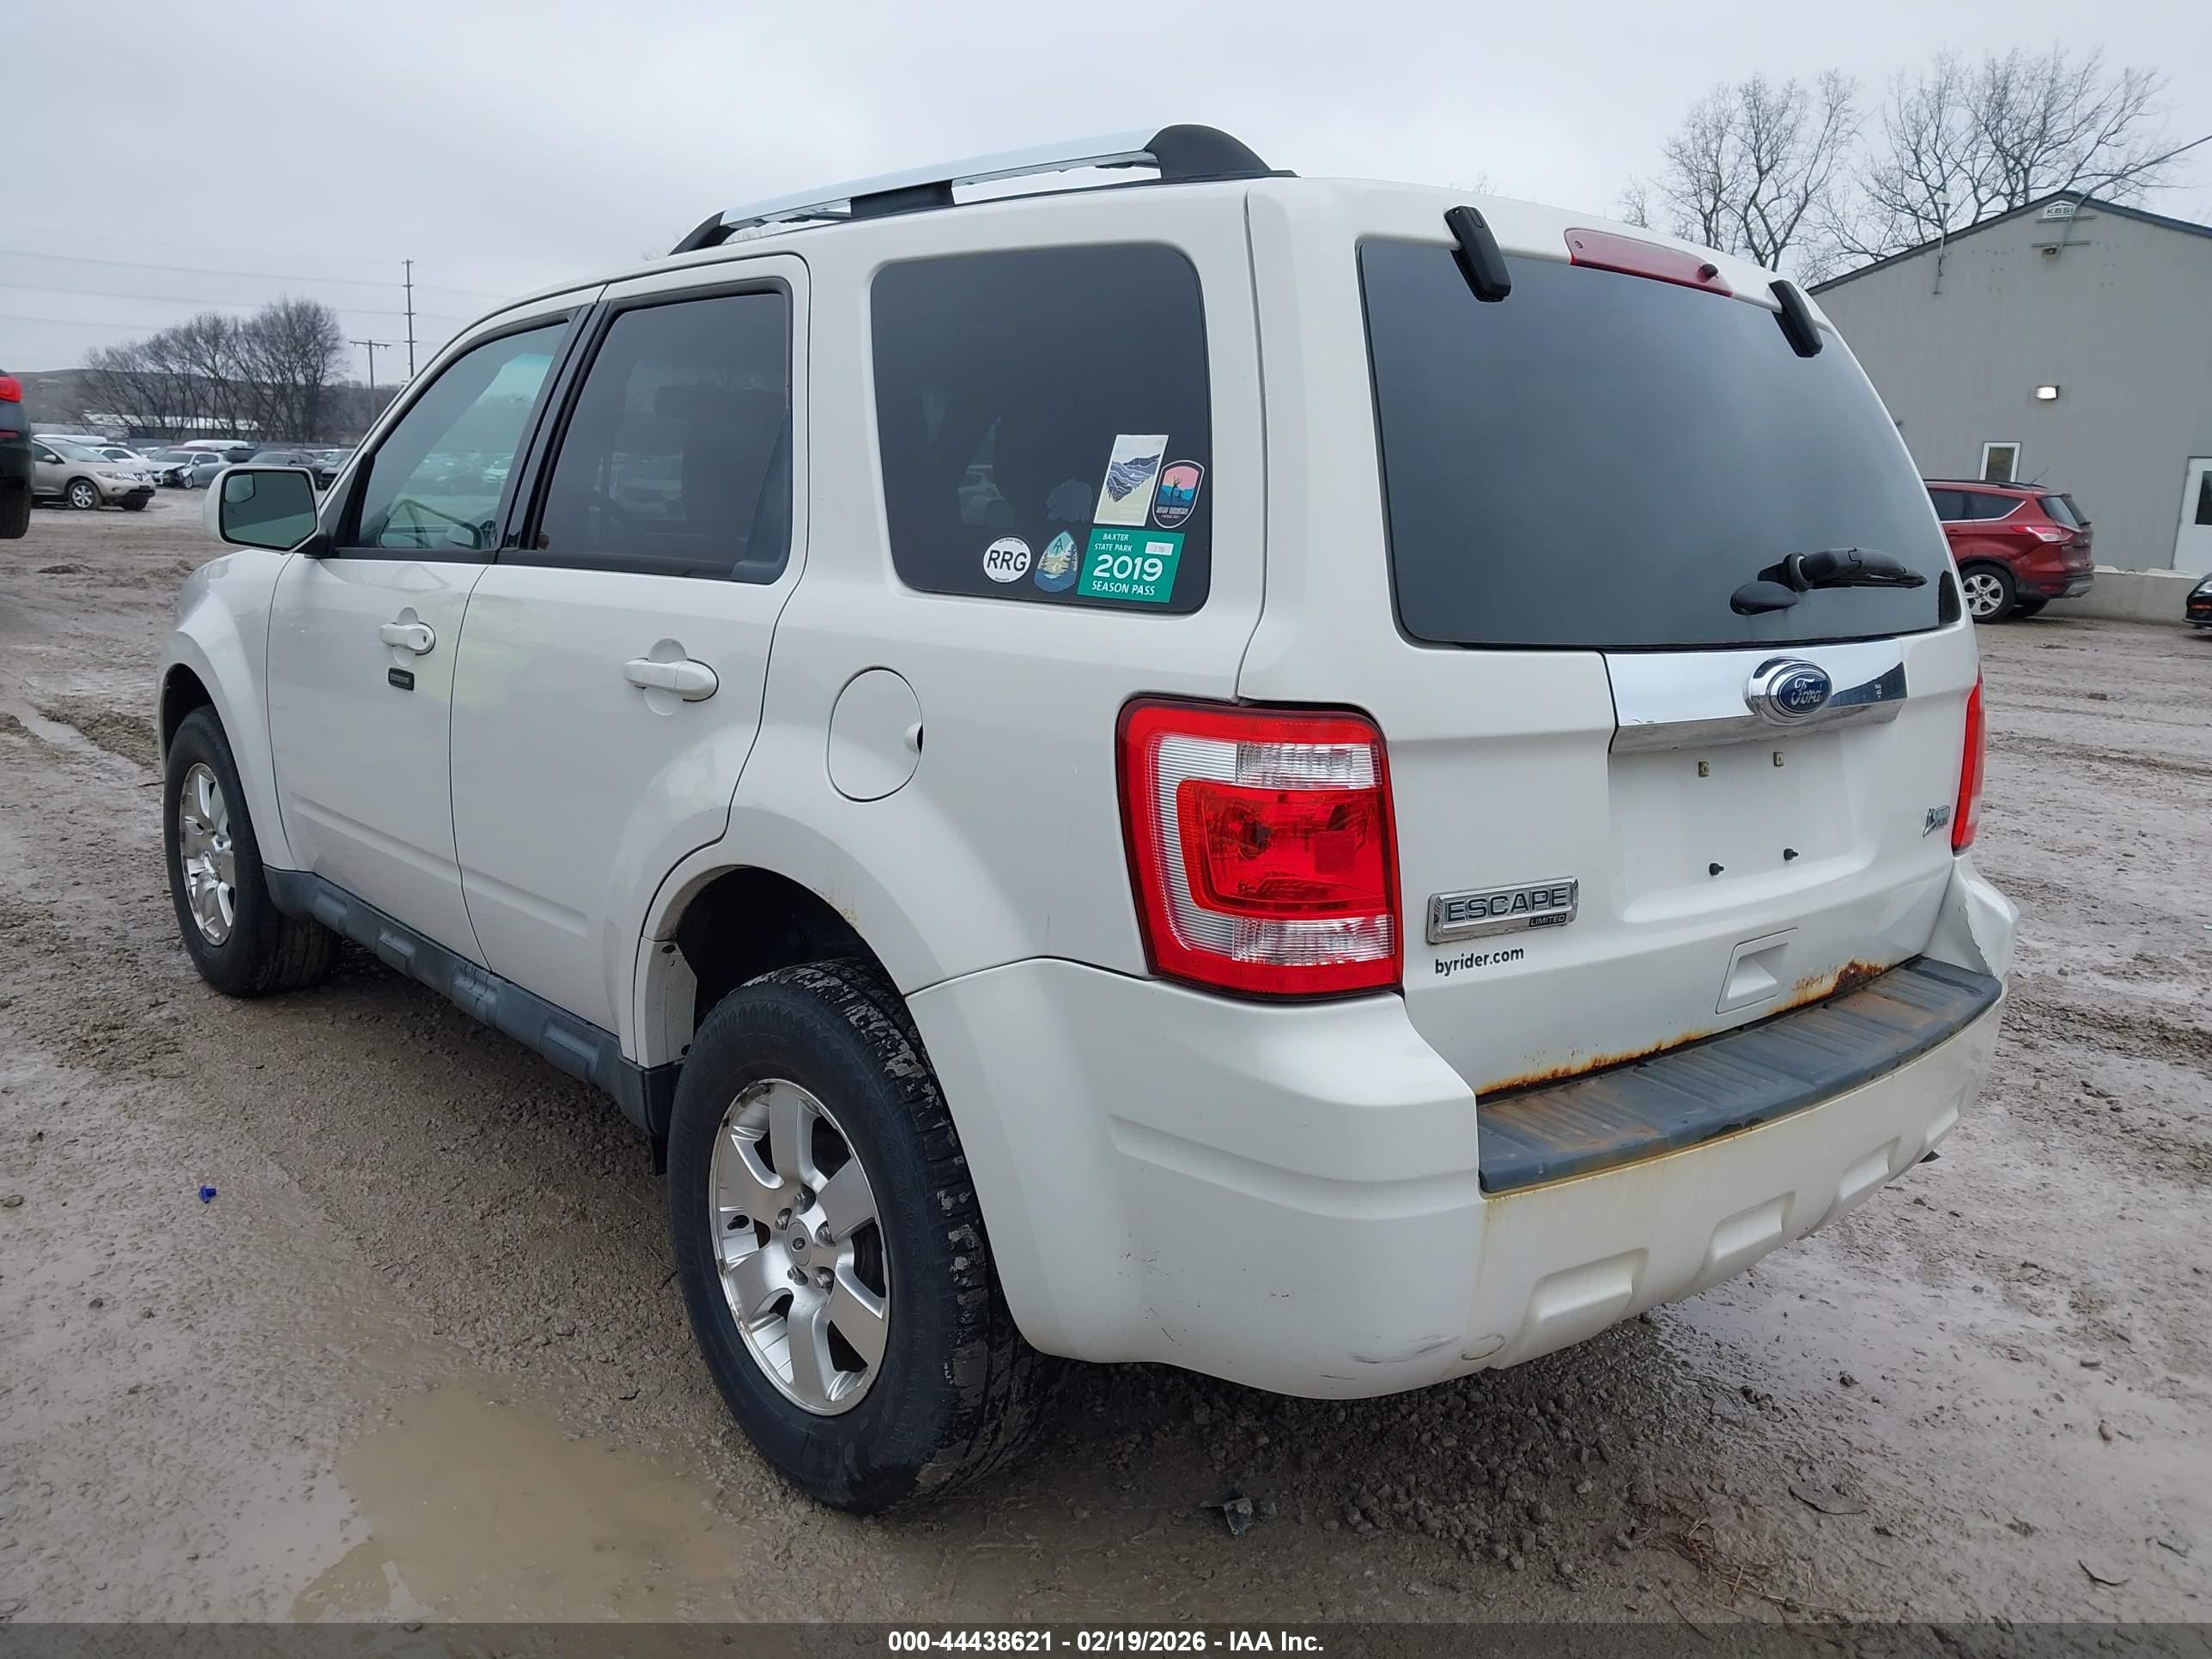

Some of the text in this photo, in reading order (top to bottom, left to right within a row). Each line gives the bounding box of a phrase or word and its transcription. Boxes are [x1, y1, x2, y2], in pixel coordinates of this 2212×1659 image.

[1094, 543, 1133, 553] STATE PARK
[1103, 533, 1129, 542] BAXTER
[987, 550, 1028, 572] RRG
[1093, 554, 1164, 582] 2019
[1091, 580, 1156, 596] SEASON PASS
[1791, 678, 1823, 706] Ford
[1447, 886, 1569, 922] ESCAPE
[1530, 914, 1566, 927] LIMITED
[1435, 947, 1525, 977] byrider.com
